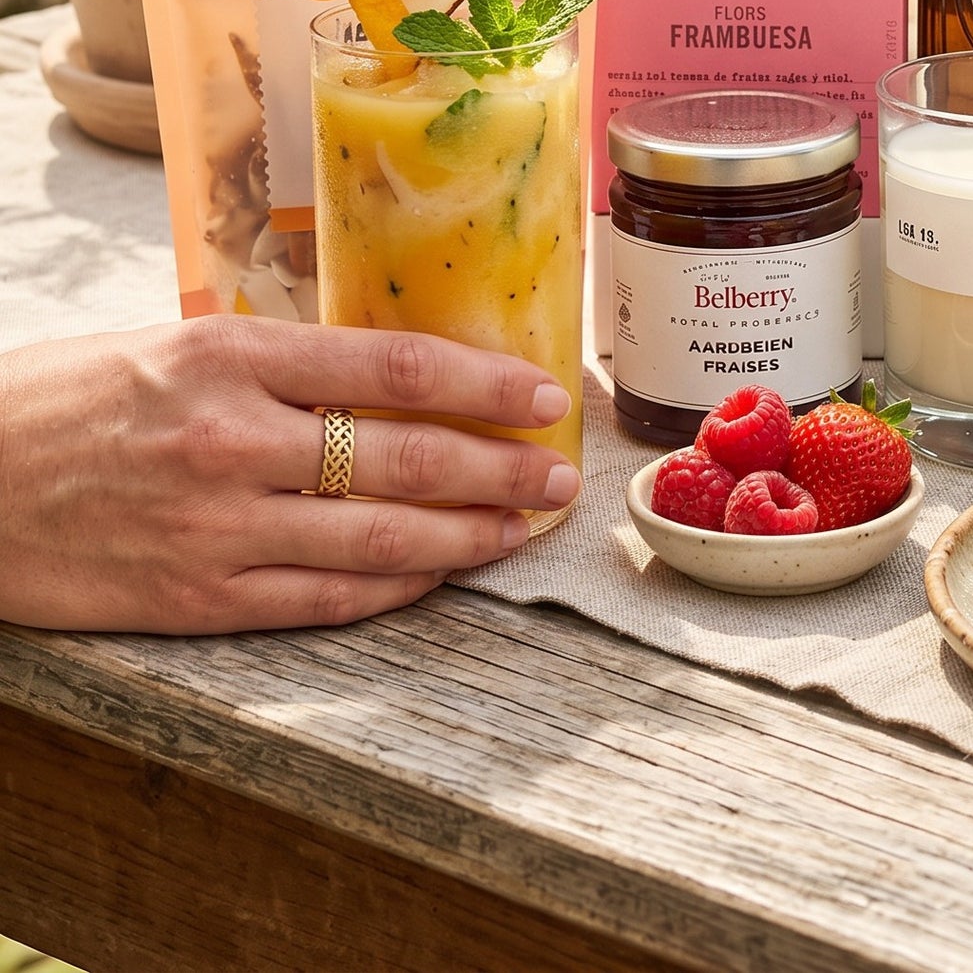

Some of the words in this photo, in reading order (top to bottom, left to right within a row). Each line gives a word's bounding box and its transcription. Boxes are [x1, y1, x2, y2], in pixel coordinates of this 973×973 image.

[714, 5, 767, 21] FLORS
[670, 24, 812, 49] FRAMBUESA
[714, 72, 727, 82] de
[694, 285, 795, 312] Belberry
[670, 316, 719, 328] ROTAL
[688, 337, 794, 354] AARDBEIEN
[703, 358, 780, 374] FRAISES
